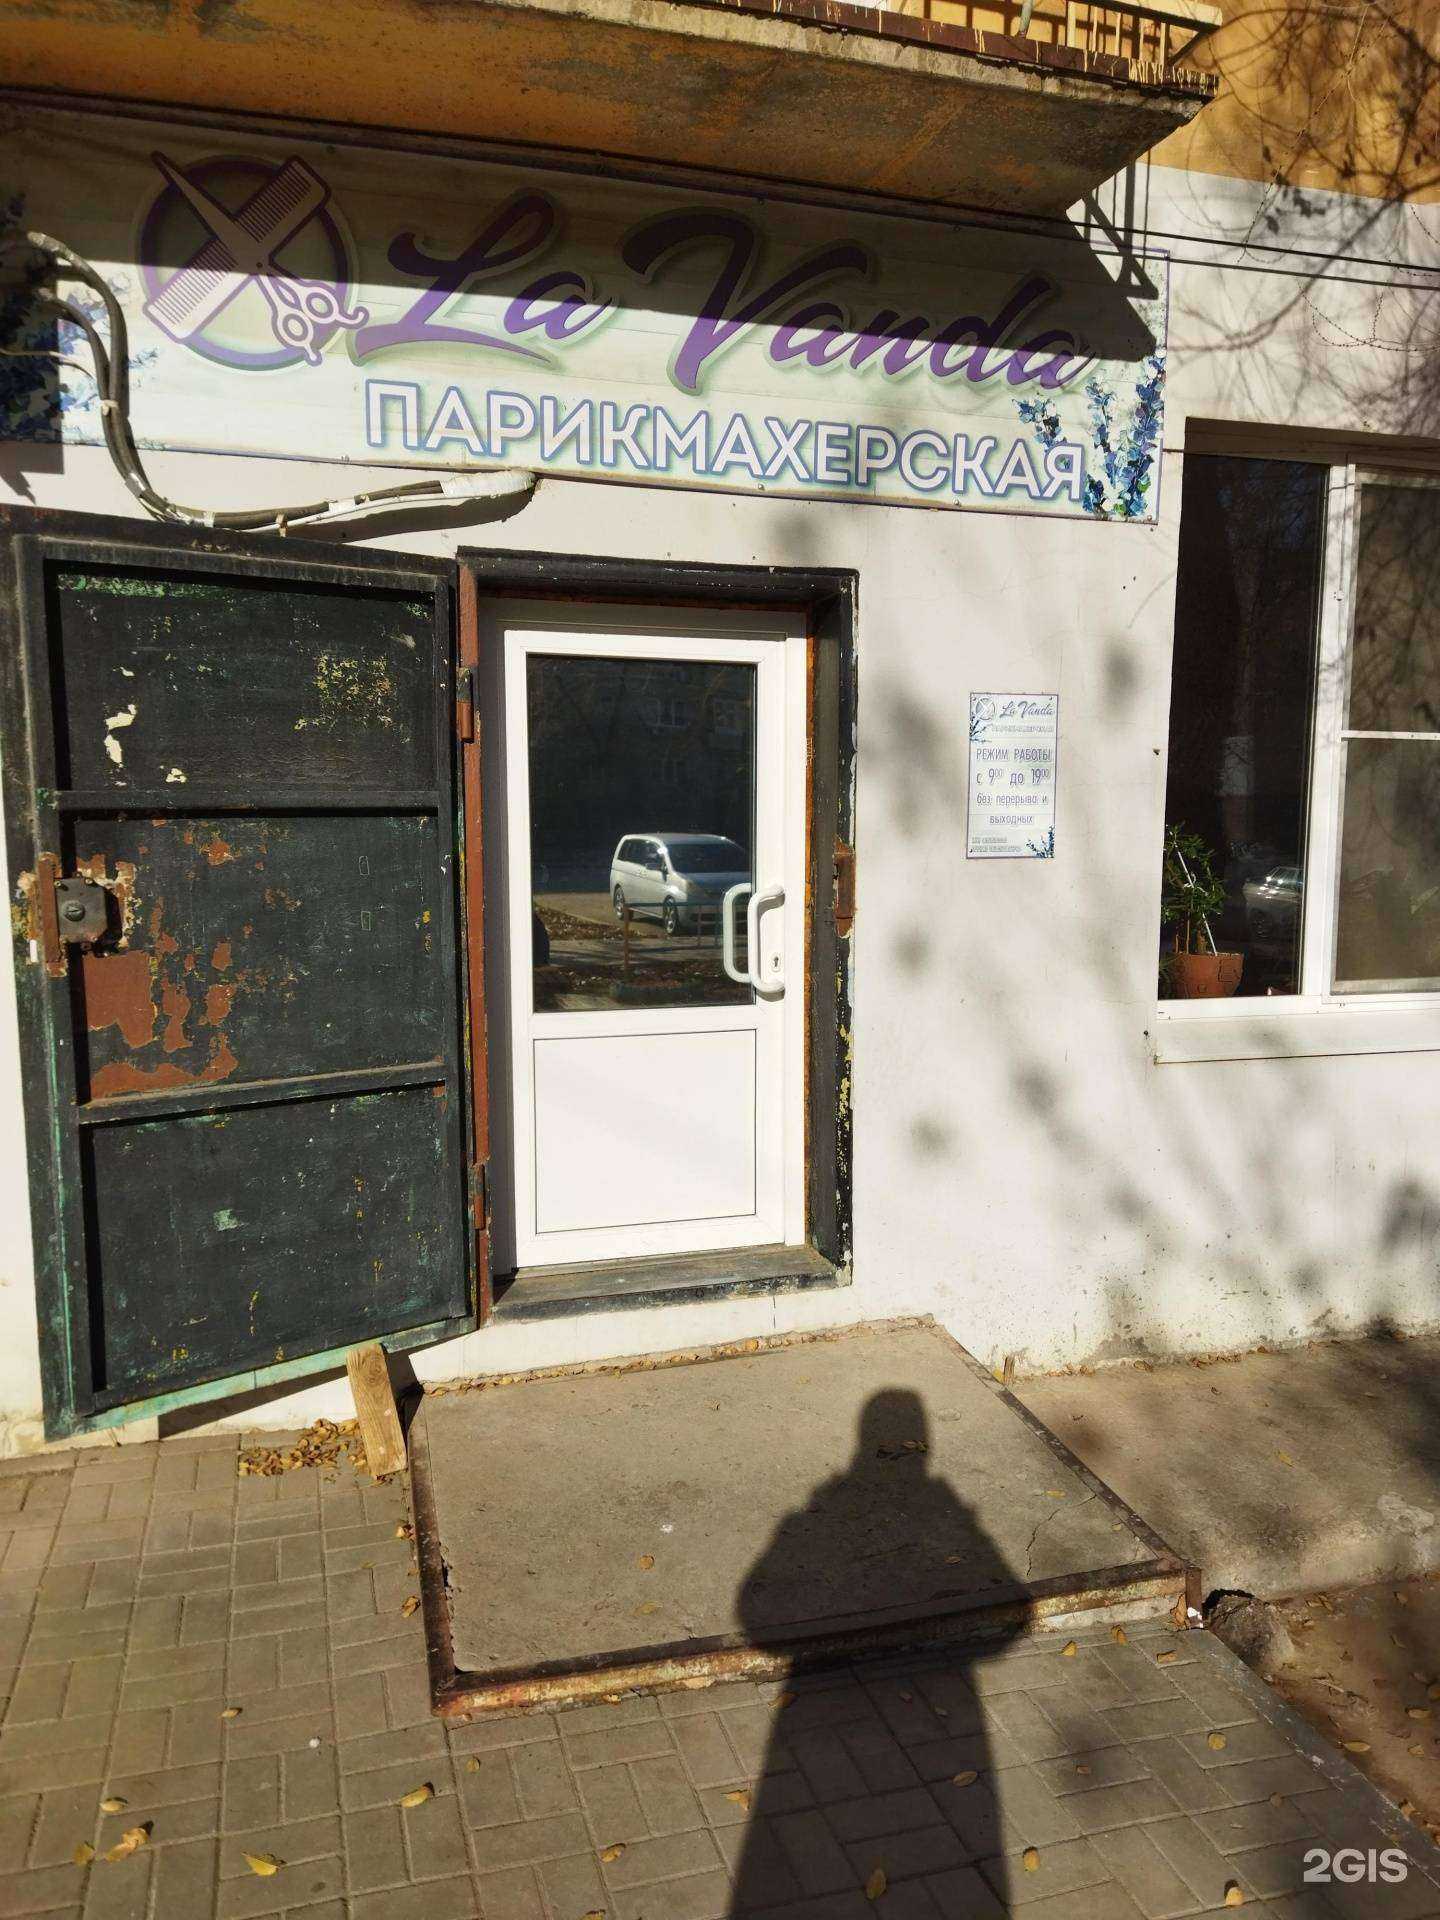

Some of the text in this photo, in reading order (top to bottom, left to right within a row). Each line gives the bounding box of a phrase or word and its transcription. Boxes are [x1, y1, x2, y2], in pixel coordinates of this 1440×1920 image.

[352, 194, 1106, 392] La Vanda
[364, 379, 1086, 502] ПАРИКМАХЕРСКАЯ
[1017, 700, 1054, 718] Vanda
[976, 748, 1051, 761] РЕЖИМ РАБОТЫ
[976, 792, 991, 804] без
[996, 794, 1038, 807] перерыва
